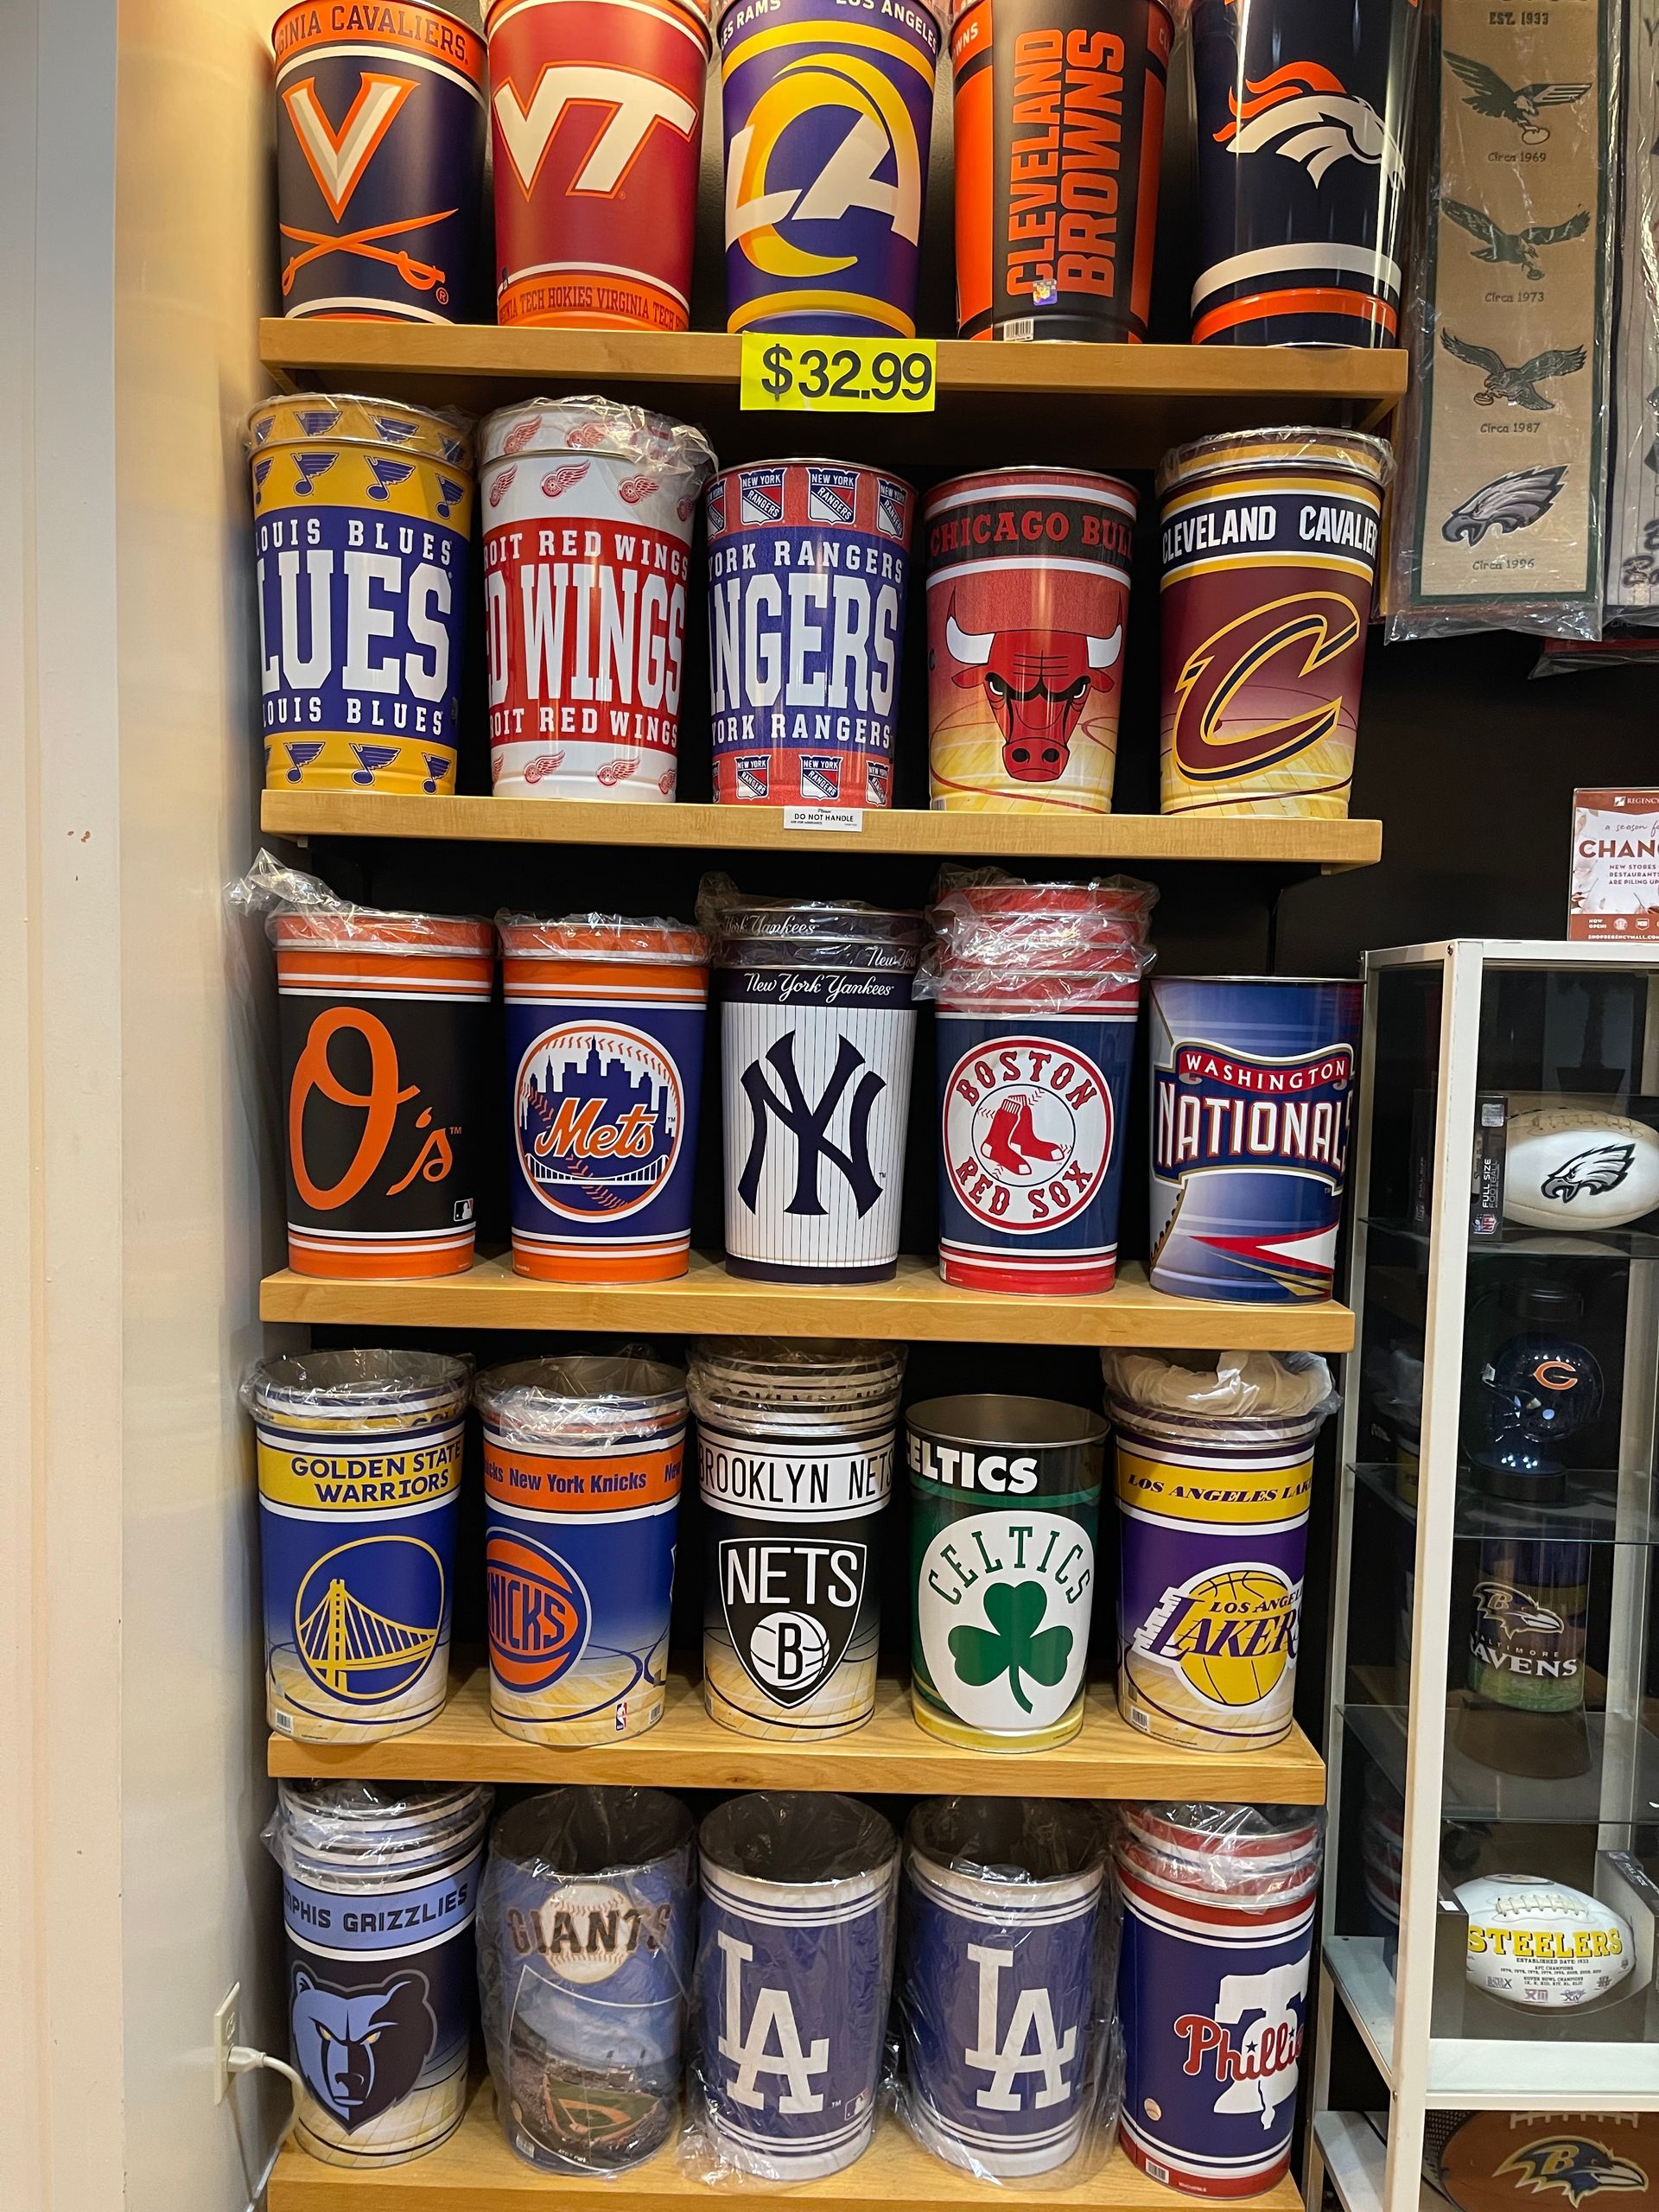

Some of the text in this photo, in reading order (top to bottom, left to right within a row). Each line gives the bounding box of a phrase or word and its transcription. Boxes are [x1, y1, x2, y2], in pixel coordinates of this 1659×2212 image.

[275, 10, 322, 57] GINIA
[1489, 11, 1548, 25] EST. 1933
[282, 72, 421, 223] V
[493, 60, 698, 201] VT
[1007, 29, 1064, 296] CLEVELAND
[1057, 29, 1125, 298] BROWNS
[1488, 151, 1547, 162] Circa 1969
[725, 105, 921, 257] LA
[547, 286, 593, 308] HOKIES
[596, 287, 649, 320] VIRGINIA
[1484, 292, 1545, 302] Circa 1973
[761, 342, 932, 402] $32.99
[1480, 422, 1541, 434] Circa 1987
[742, 474, 781, 488] NEW YORK
[747, 489, 780, 518] RANGERS
[811, 474, 854, 487] NEW YORK
[817, 486, 852, 521] RANGERS
[348, 518, 452, 566] BLUES
[538, 530, 601, 556] RED
[614, 534, 688, 582] WINGS
[930, 510, 1071, 556] CHICAGO
[1162, 505, 1277, 565] CLEVELAND
[773, 540, 903, 585] RANGERS
[1472, 558, 1535, 571] Circa 1996
[520, 563, 685, 716] WINGS
[708, 572, 899, 717] NGERS
[346, 697, 443, 736] BLUES
[539, 706, 599, 734] RED
[610, 709, 678, 749] WINGS
[771, 713, 891, 750] RANGERS
[737, 760, 766, 770] NEW YORK
[803, 760, 839, 770] NEW YORK
[1579, 839, 1659, 859] CHAN
[744, 972, 893, 1004] New York Yankees
[955, 1051, 1098, 1111] BOSTON
[1185, 1053, 1345, 1091] WASHINGTON
[533, 1097, 655, 1160] Mets
[738, 1028, 887, 1220] NY
[955, 1156, 1095, 1220] RED SOX
[1482, 1183, 1491, 1209] FULL
[1489, 1160, 1498, 1209] FOOTBALL
[291, 1440, 461, 1479] GOLDEN STATE
[509, 1467, 647, 1494] New York Knicks
[698, 1442, 829, 1503] BROOKLYN
[907, 1429, 1038, 1494] ELTICS
[315, 1468, 449, 1503] WARRIORS
[1128, 1474, 1165, 1493] LOS
[1168, 1485, 1278, 1503] ANGELES
[727, 1547, 858, 1607] NETS
[928, 1526, 1090, 1605] CELTICS
[489, 1572, 566, 1651] NICKS
[1147, 1594, 1299, 1662] LAKER
[1209, 1601, 1251, 1614] LOS
[343, 1884, 468, 1933] GRIZZLIES
[507, 1903, 671, 1955] GIANTS
[1468, 1924, 1624, 1959] STEELERS
[718, 1930, 830, 2114] LA
[964, 1943, 1077, 2112] LA
